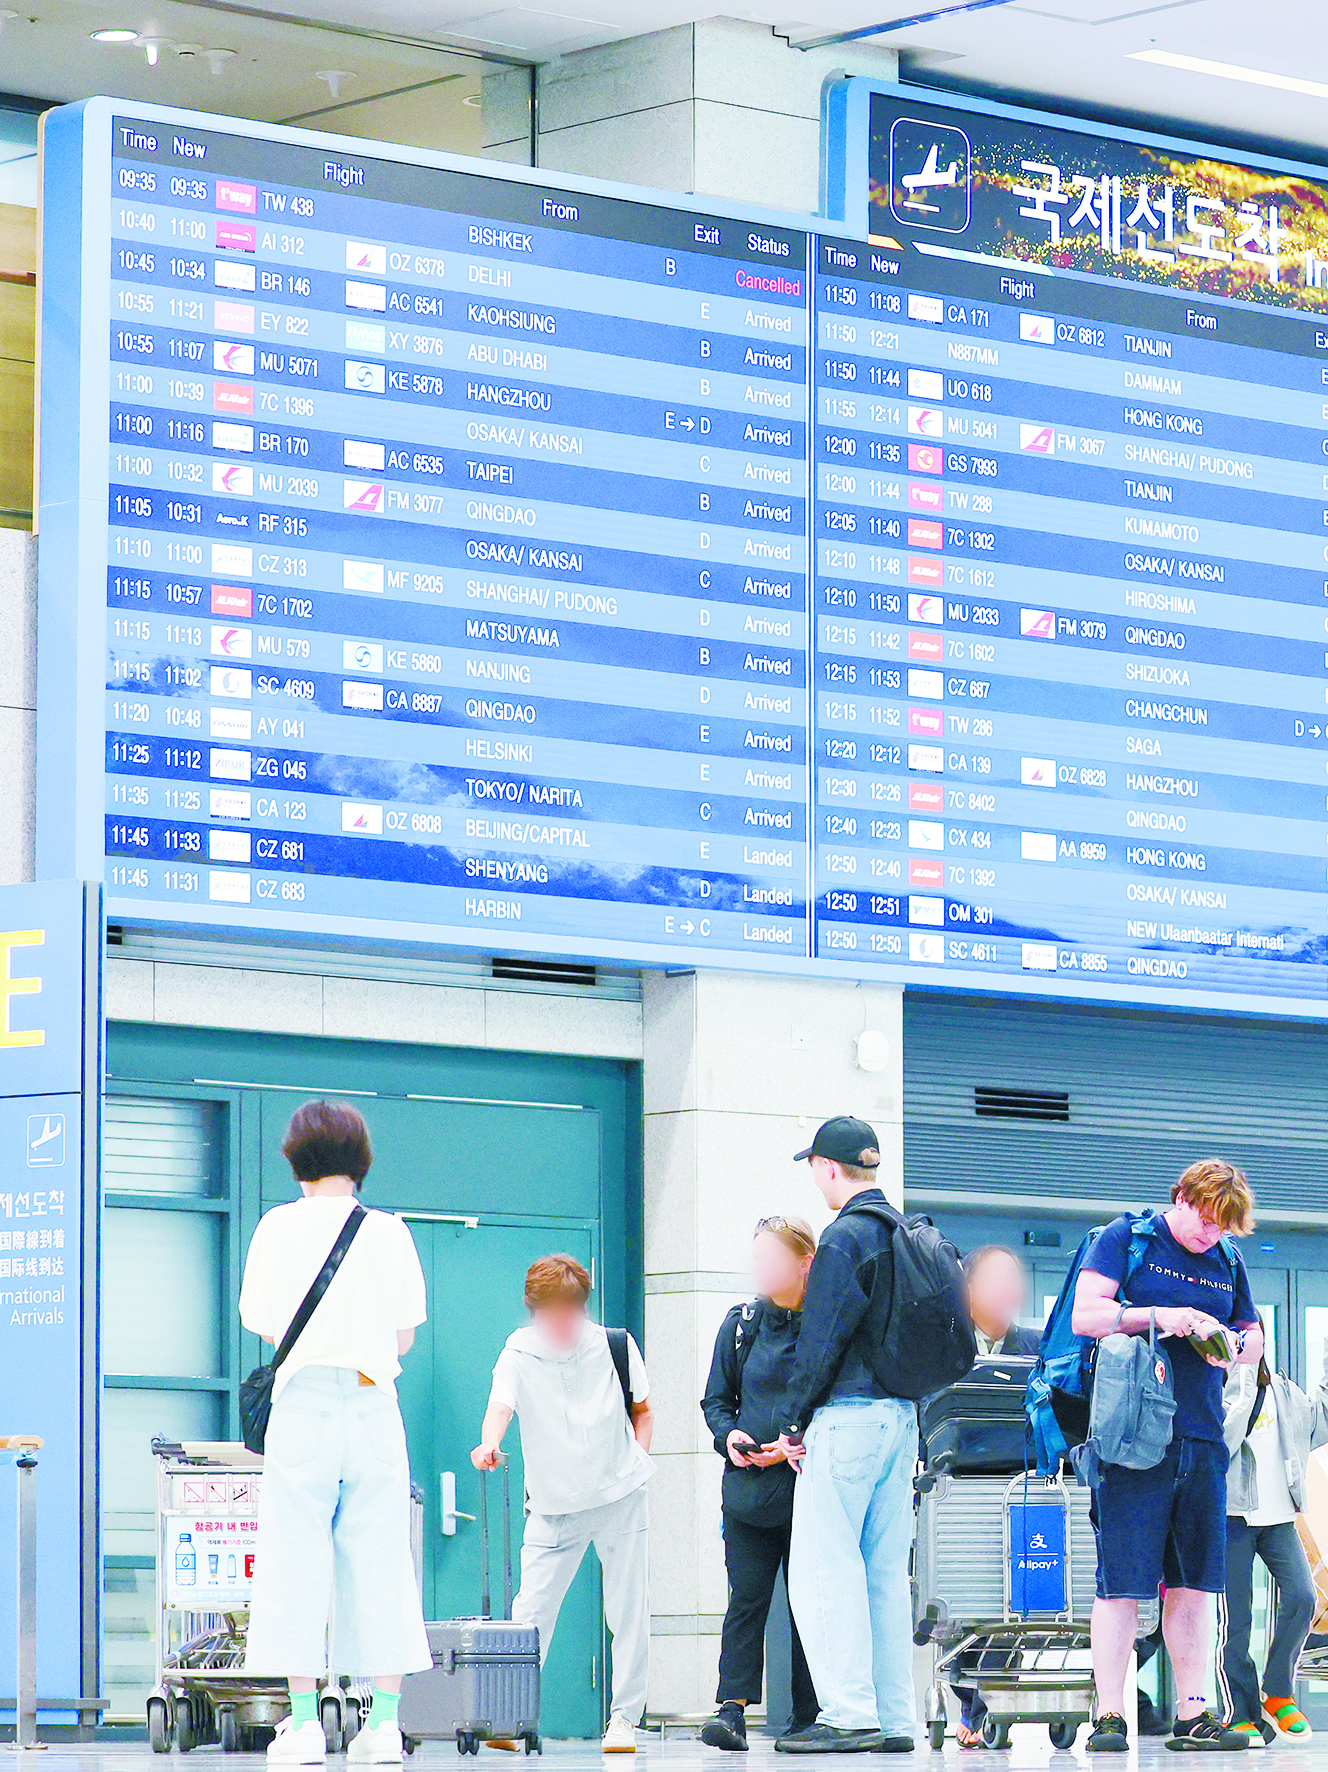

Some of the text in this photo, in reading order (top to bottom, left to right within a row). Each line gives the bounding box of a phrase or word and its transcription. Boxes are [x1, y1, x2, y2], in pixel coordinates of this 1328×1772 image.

[119, 168, 156, 192] 09:35
[170, 177, 207, 200] 09:35
[261, 191, 287, 212] TW
[290, 196, 314, 217] 438
[468, 225, 533, 253] BISHKEK
[666, 258, 676, 275] B
[735, 269, 801, 296] Cancelled
[120, 127, 789, 256] Time New Flight From Exit Status
[1012, 159, 1289, 283] 국제선도착
[118, 249, 791, 370] 10:45 10:34 BR 146 AC 6541 KAOHSIUNG B Arrived
[824, 246, 857, 268] Time
[871, 254, 899, 275] New
[1000, 276, 1035, 300] Flight
[1187, 309, 1217, 330] From
[825, 284, 857, 306] 11:50
[869, 292, 901, 313] 11:08
[947, 305, 967, 324] CA
[970, 309, 989, 328] 171
[1057, 323, 1076, 342] OZ
[1078, 327, 1105, 347] 6812
[1123, 334, 1172, 358] TIANJIN
[117, 331, 791, 446] 10:55 11:07 MU 5071 KE 5878 HANGZHOU E D Arrived
[824, 397, 857, 419] 11:55
[869, 404, 901, 425] 12:14
[947, 416, 969, 435] MU
[972, 419, 997, 440] 5041
[1057, 433, 1077, 452] FM
[1079, 436, 1106, 456] 3067
[1124, 443, 1197, 472] SHANGHAI/
[1199, 455, 1254, 479] PUDONG
[115, 495, 152, 517] 11:05
[166, 501, 201, 523] 10:31
[259, 513, 280, 533] RF
[283, 516, 307, 537] 315
[466, 540, 525, 566] OSAKA/
[529, 548, 582, 572] KANSAI
[699, 570, 711, 588] C
[743, 576, 791, 599] Arrived
[824, 586, 856, 607] 12:10
[869, 592, 901, 613] 11:50
[948, 602, 969, 622] MU
[972, 606, 1000, 626] 2033
[1058, 617, 1077, 636] FM
[1080, 620, 1107, 640] 3079
[1125, 626, 1185, 650] QINGDAO
[112, 742, 150, 764] 11:25
[164, 747, 201, 769] 11:12
[256, 757, 279, 777] ZG
[283, 759, 307, 780] 045
[465, 778, 525, 804] TOKYO/
[529, 785, 583, 808] NARITA
[700, 802, 711, 821] C
[744, 807, 792, 829] Arrived
[112, 825, 793, 906] 11:45 11:33 CZ 681 SHENYANG D Landed
[825, 891, 857, 912] 12:50
[869, 895, 900, 916] 12:51
[948, 903, 971, 922] OM
[973, 905, 993, 924] 301
[1127, 919, 1158, 939] NEW
[1160, 923, 1234, 946] Ulaanbaatar
[1236, 930, 1285, 951] Internati
[0, 929, 46, 1049] E
[0, 1256, 64, 1278] 国际线到达
[1148, 1263, 1186, 1281] TOMMY
[9, 1306, 64, 1326] Arrivals
[195, 1521, 223, 1532] 항공기
[227, 1522, 236, 1532] 내
